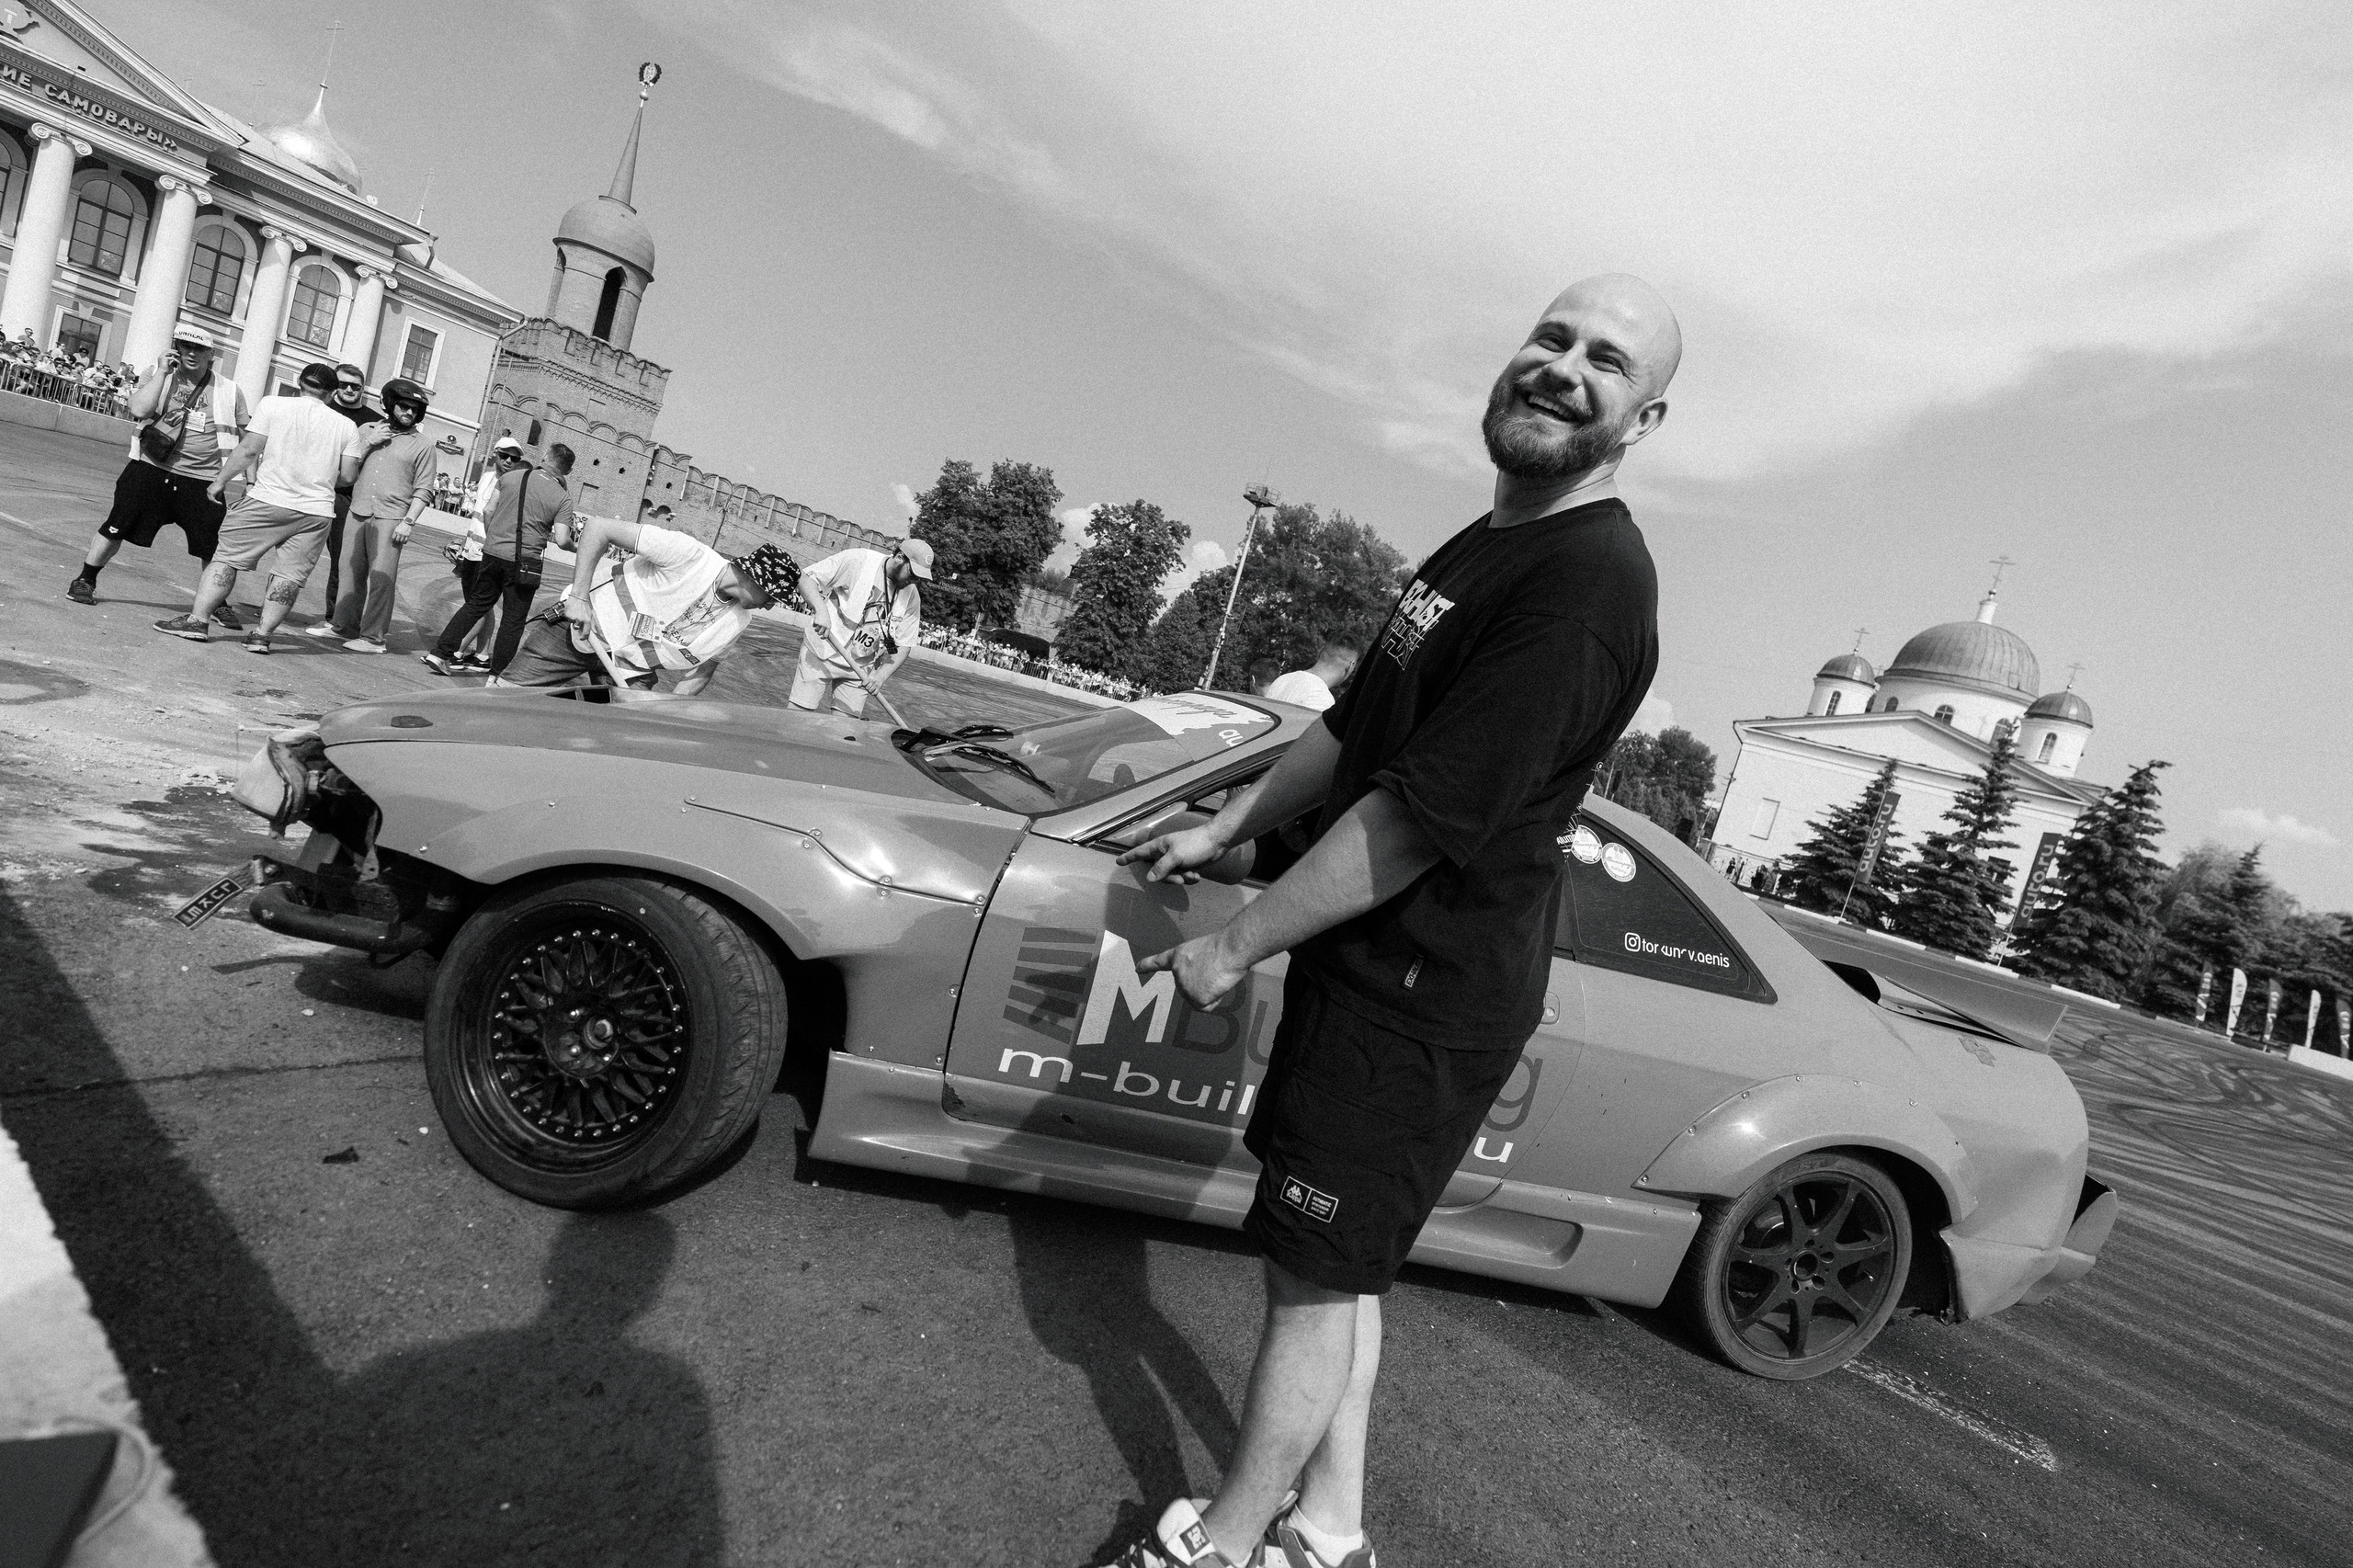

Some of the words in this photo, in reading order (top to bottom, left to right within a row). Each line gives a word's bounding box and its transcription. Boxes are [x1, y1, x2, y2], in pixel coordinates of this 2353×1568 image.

[44, 84, 178, 152] САМОВАРЫ»
[855, 630, 875, 647] M3
[1859, 803, 1893, 873] auto.ru
[2021, 843, 2055, 918] auto.ru
